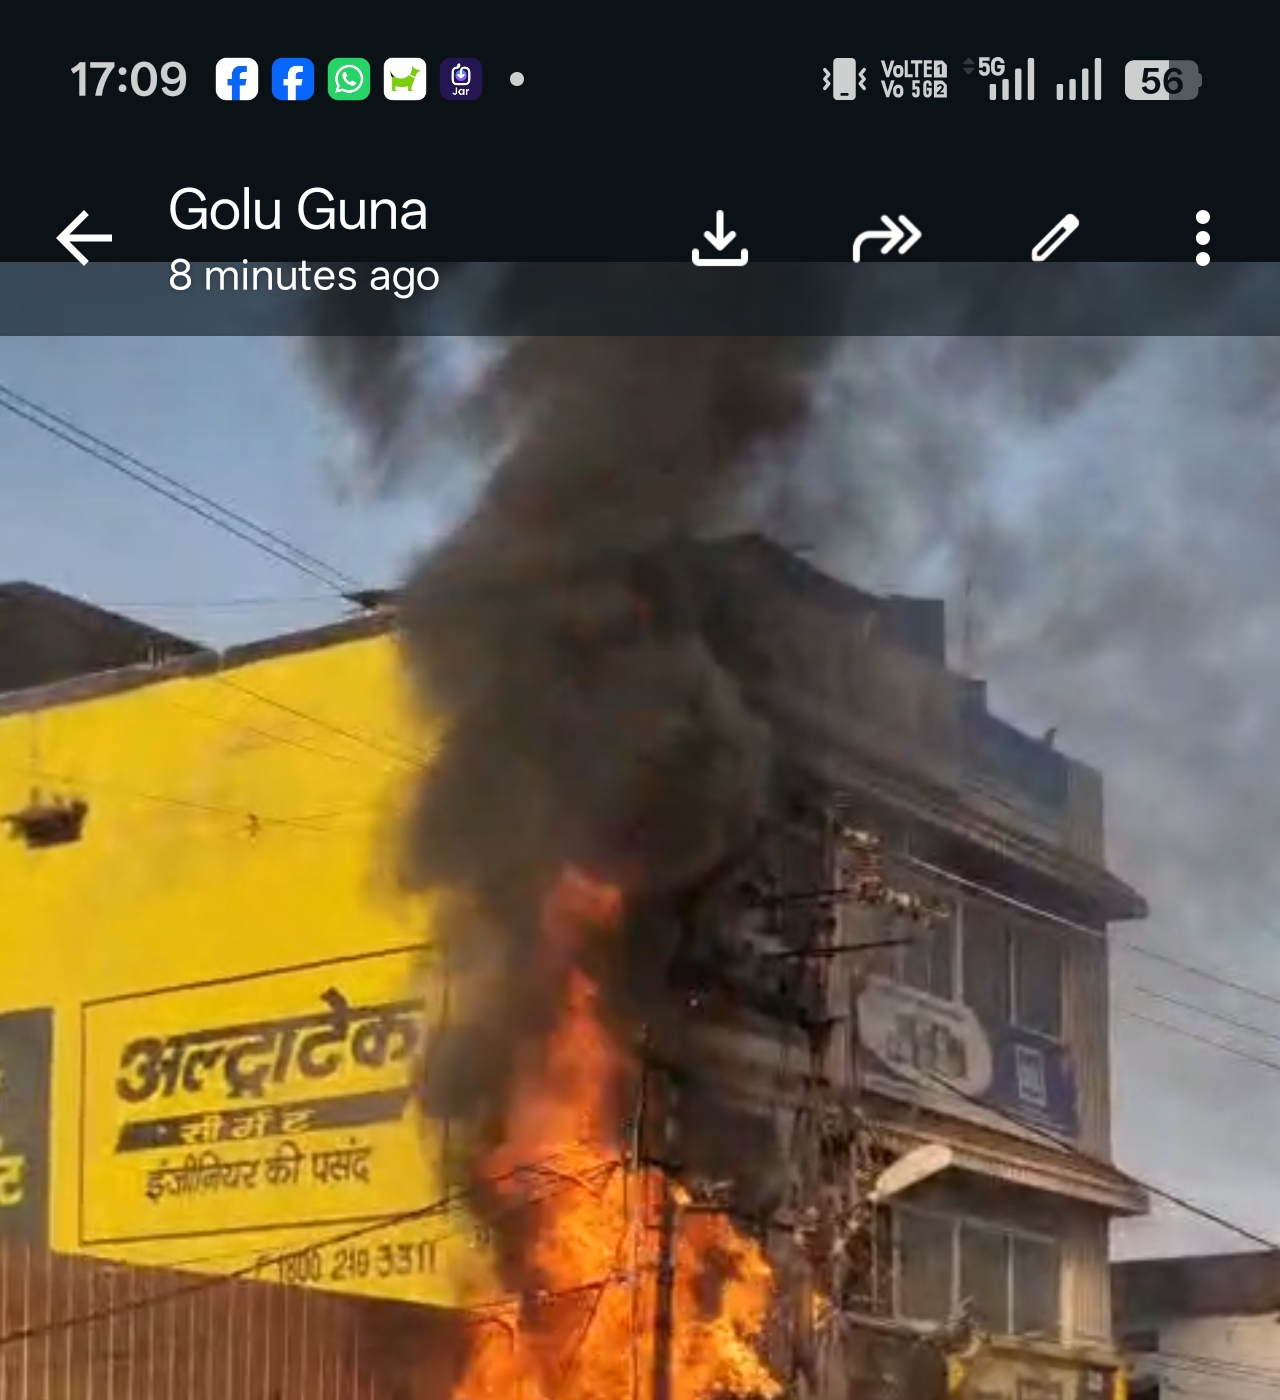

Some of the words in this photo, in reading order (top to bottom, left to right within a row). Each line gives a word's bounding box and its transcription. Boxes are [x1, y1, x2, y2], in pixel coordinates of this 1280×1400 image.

[116, 986, 426, 1102] अल्ट्राटेक
[145, 1150, 259, 1203] इंजीनियर
[265, 1140, 303, 1186] की
[311, 1137, 372, 1184] पसंद
